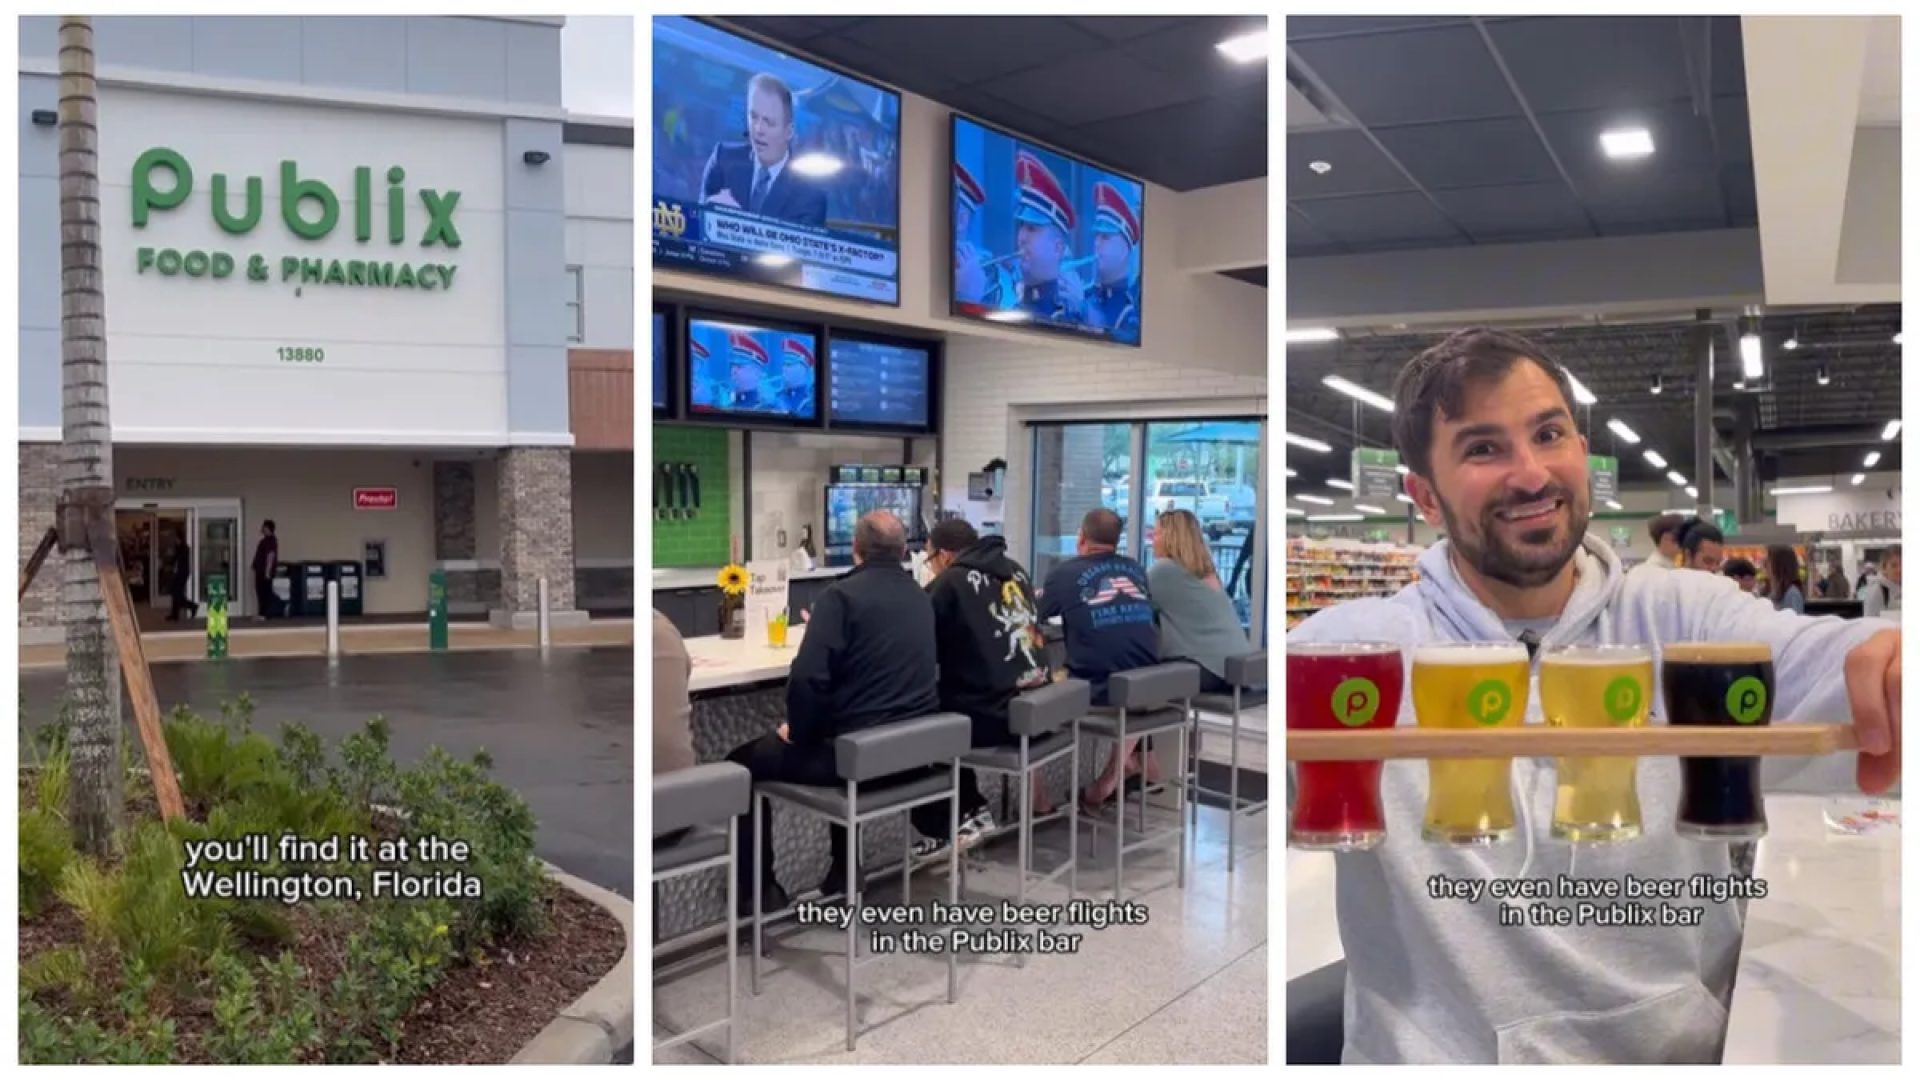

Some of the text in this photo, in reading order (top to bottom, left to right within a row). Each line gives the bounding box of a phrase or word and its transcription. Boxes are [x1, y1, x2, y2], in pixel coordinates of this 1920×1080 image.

[131, 146, 463, 249] Publix
[717, 218, 740, 233] WHO
[741, 224, 764, 236] WILL
[779, 232, 801, 246] OHIO
[137, 247, 458, 291] FOOD & PHARMACY
[276, 347, 325, 363] 13880
[126, 477, 175, 491] ENTRY
